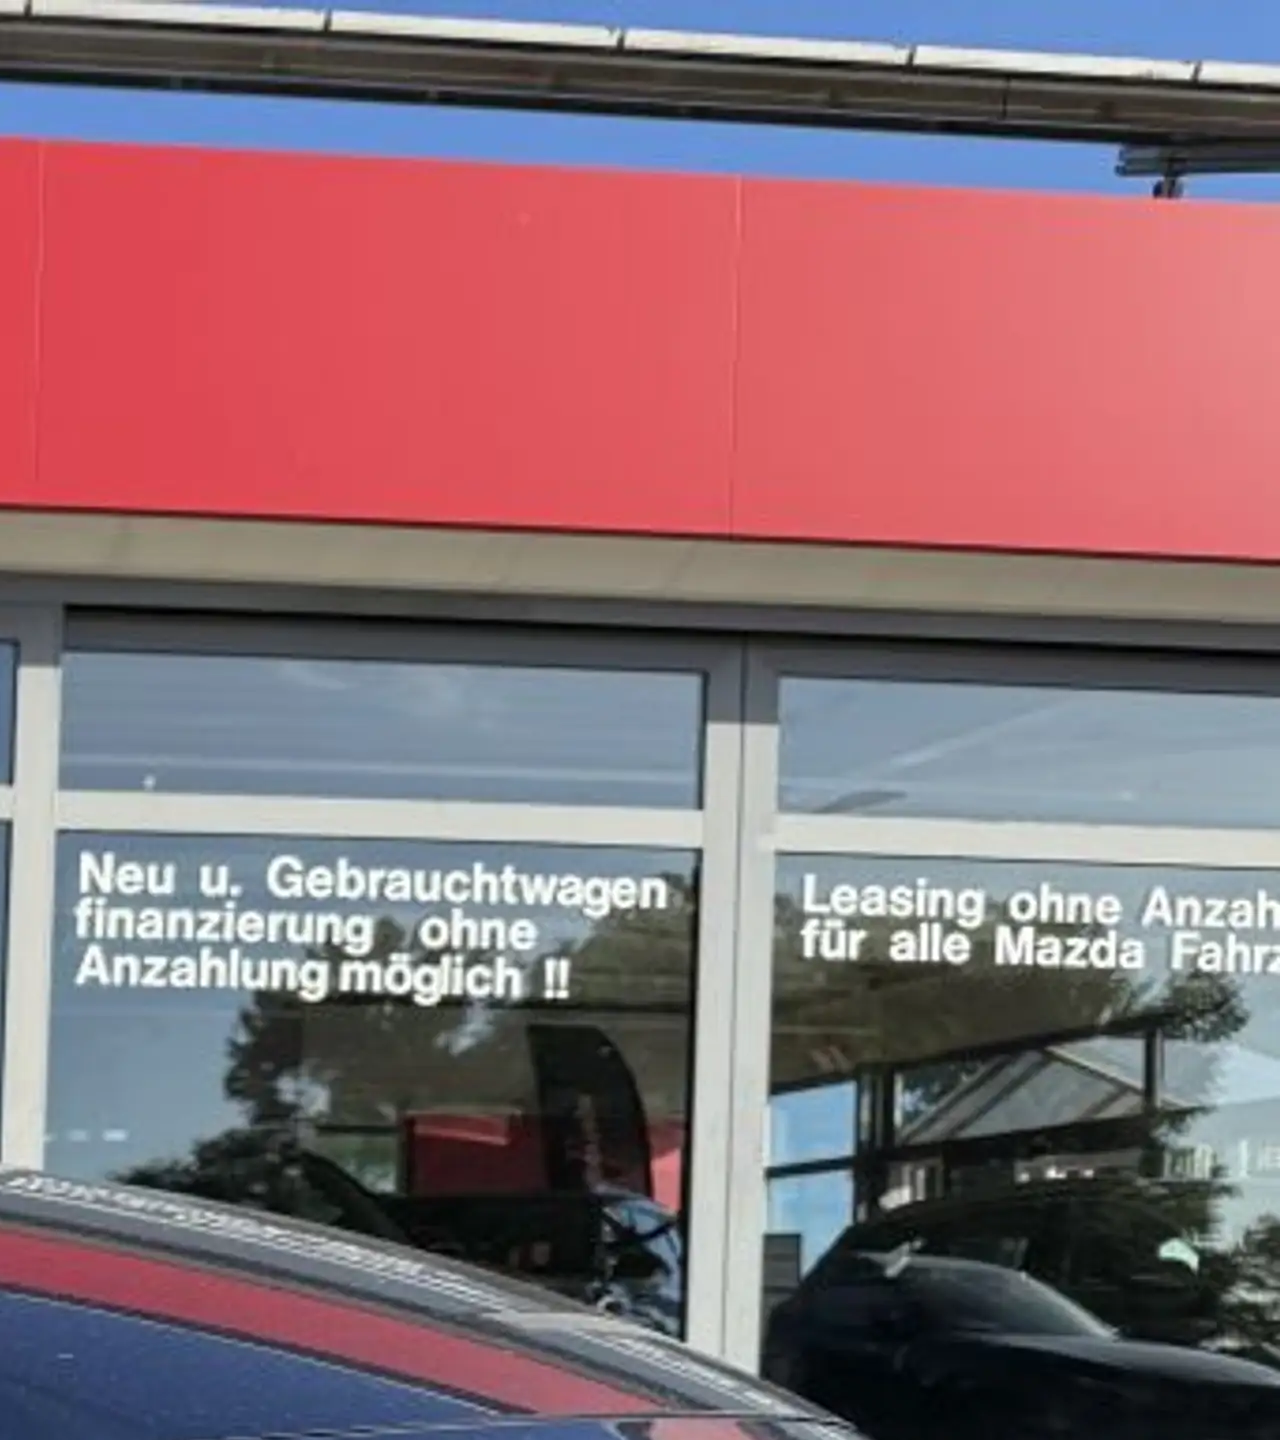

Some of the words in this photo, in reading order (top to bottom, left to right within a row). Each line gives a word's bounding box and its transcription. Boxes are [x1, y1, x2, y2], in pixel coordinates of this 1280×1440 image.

[80, 851, 174, 895] Neu
[200, 862, 241, 897] u.
[267, 855, 667, 917] Gebrauchtwagen
[802, 873, 985, 929] Leasing
[1009, 882, 1122, 924] ohne
[75, 900, 374, 955] finanzierung
[419, 910, 537, 950] ohne
[801, 917, 867, 961] für
[889, 923, 970, 963] alle
[995, 925, 1144, 969] Mazda
[75, 947, 329, 997] Anzahlung
[340, 954, 523, 1005] möglich
[544, 960, 571, 998] !!
